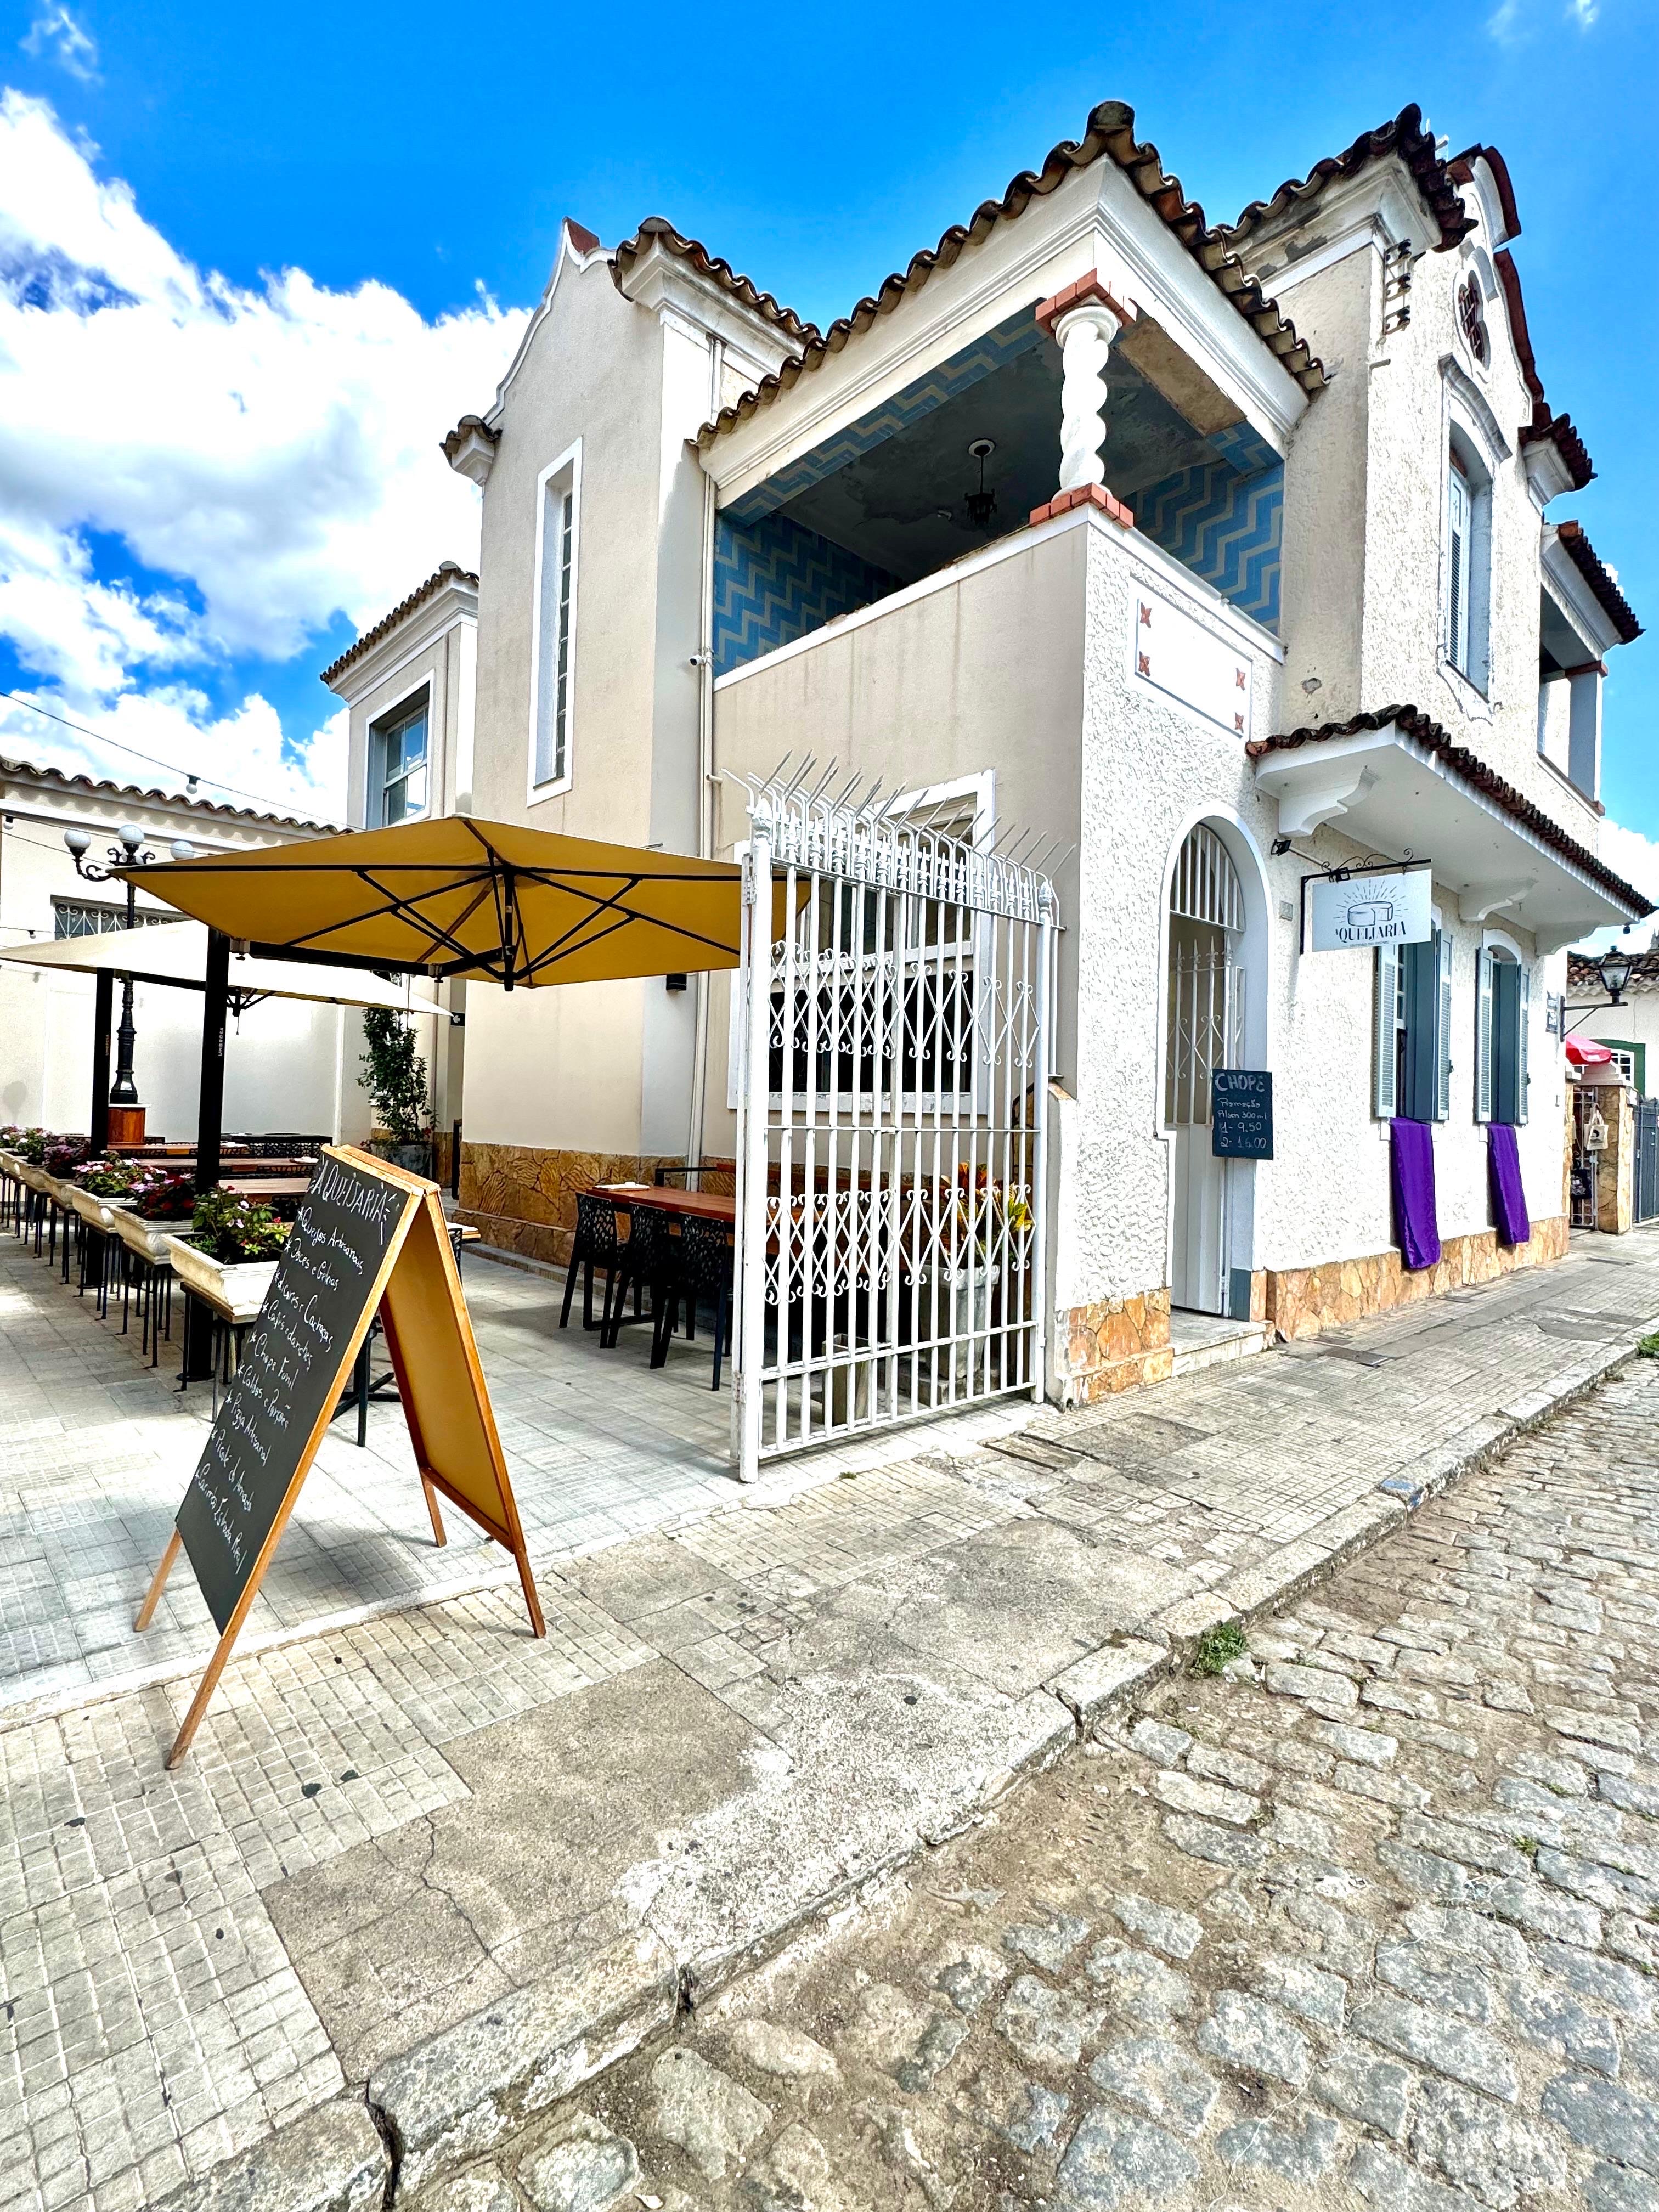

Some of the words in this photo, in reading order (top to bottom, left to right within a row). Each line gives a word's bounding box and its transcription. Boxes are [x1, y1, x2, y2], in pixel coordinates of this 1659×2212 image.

[1339, 921, 1406, 943] QUEIJARIA
[1214, 1072, 1265, 1093] CHOPE
[1217, 1097, 1261, 1109] Promoção
[1217, 1109, 1240, 1119] Pilsen
[1256, 1111, 1267, 1120] ml
[1237, 1121, 1262, 1133] 9.50
[291, 1237, 310, 1269] Doces
[301, 1207, 327, 1246] Queijos
[326, 1226, 364, 1276] Artesanais
[267, 1299, 286, 1330] Cafés
[255, 1333, 277, 1373] Chope
[242, 1365, 263, 1399] Caldos
[267, 1388, 291, 1430] Porções
[230, 1392, 246, 1431] Pizza
[243, 1414, 272, 1467] Artesanal
[215, 1428, 232, 1468] Picolé
